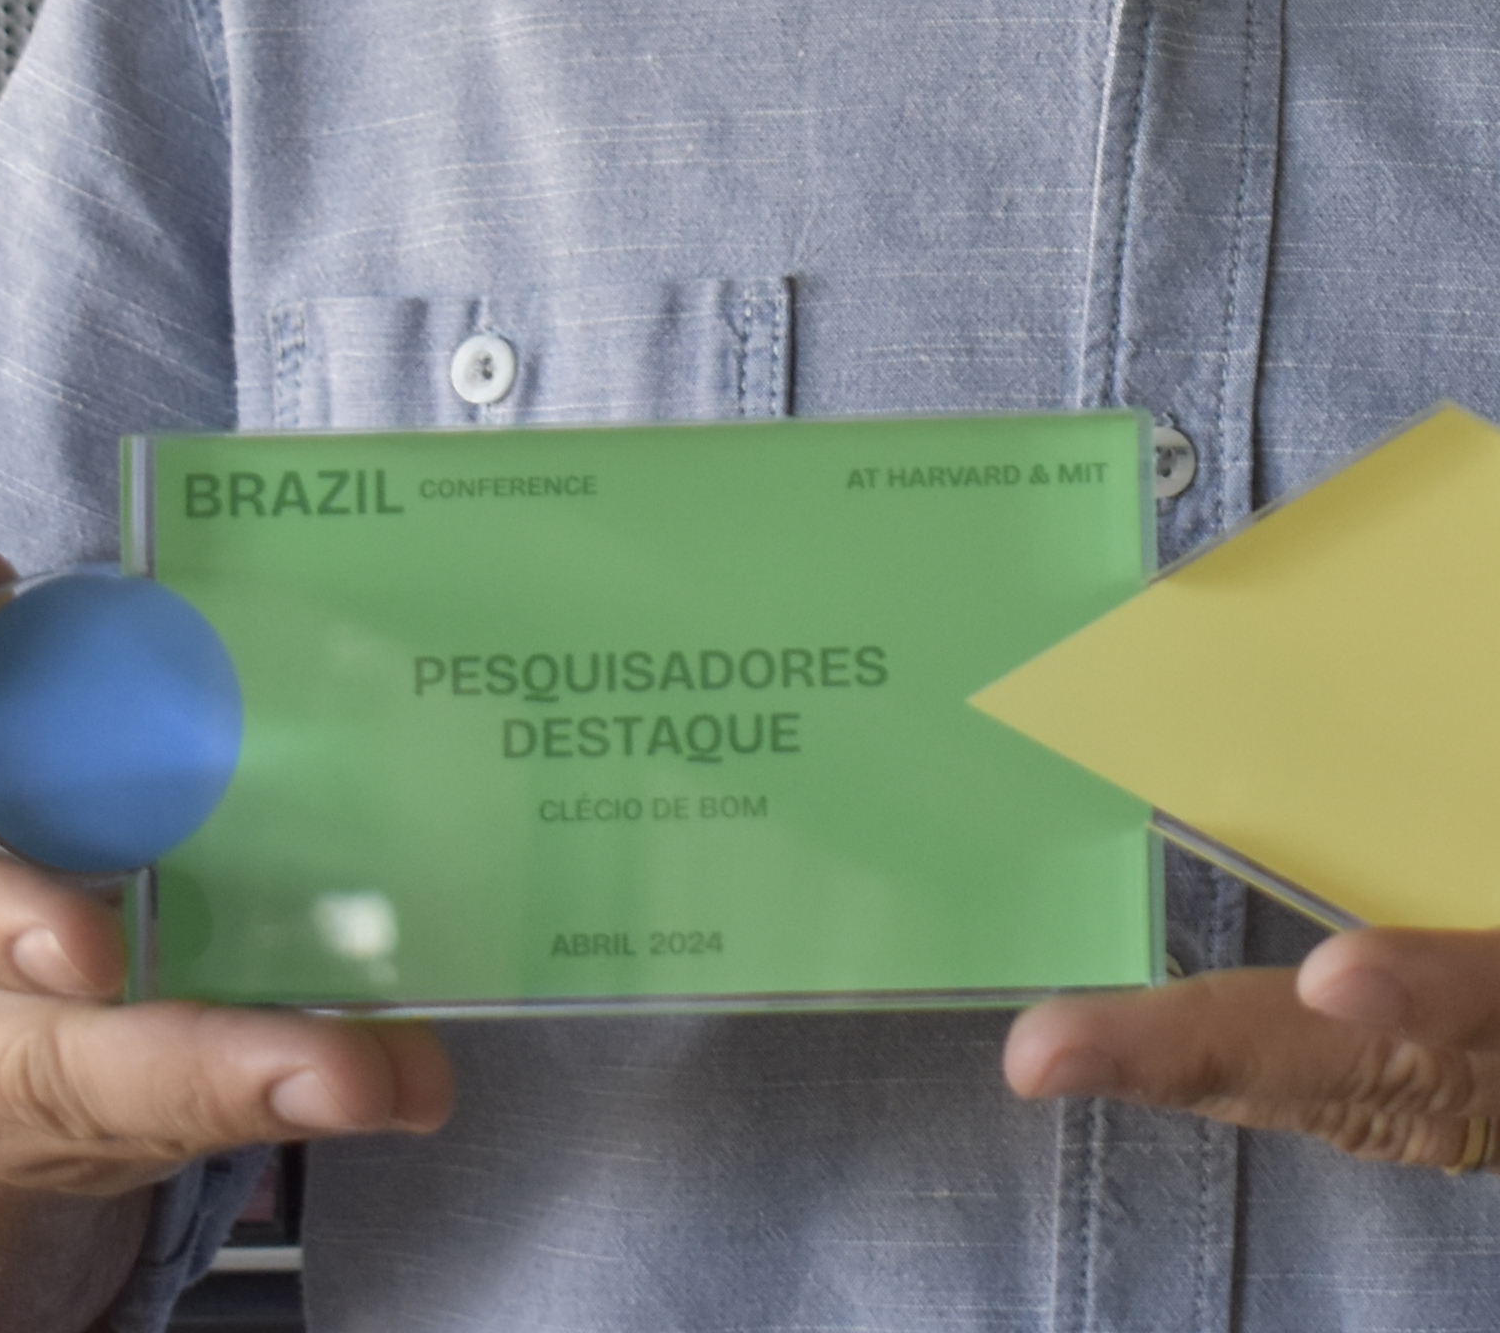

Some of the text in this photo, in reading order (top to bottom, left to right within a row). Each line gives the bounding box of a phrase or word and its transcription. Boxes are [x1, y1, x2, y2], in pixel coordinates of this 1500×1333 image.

[182, 468, 598, 521] BRAZIL CONFERENCE
[845, 461, 1107, 490] AT HARVARD & MIT
[414, 645, 889, 705] PESQUISADORES
[503, 712, 801, 765] DESTAQUE
[536, 793, 770, 826] CLÉCIO DE BOM
[548, 930, 725, 960] ABRIL 2024
